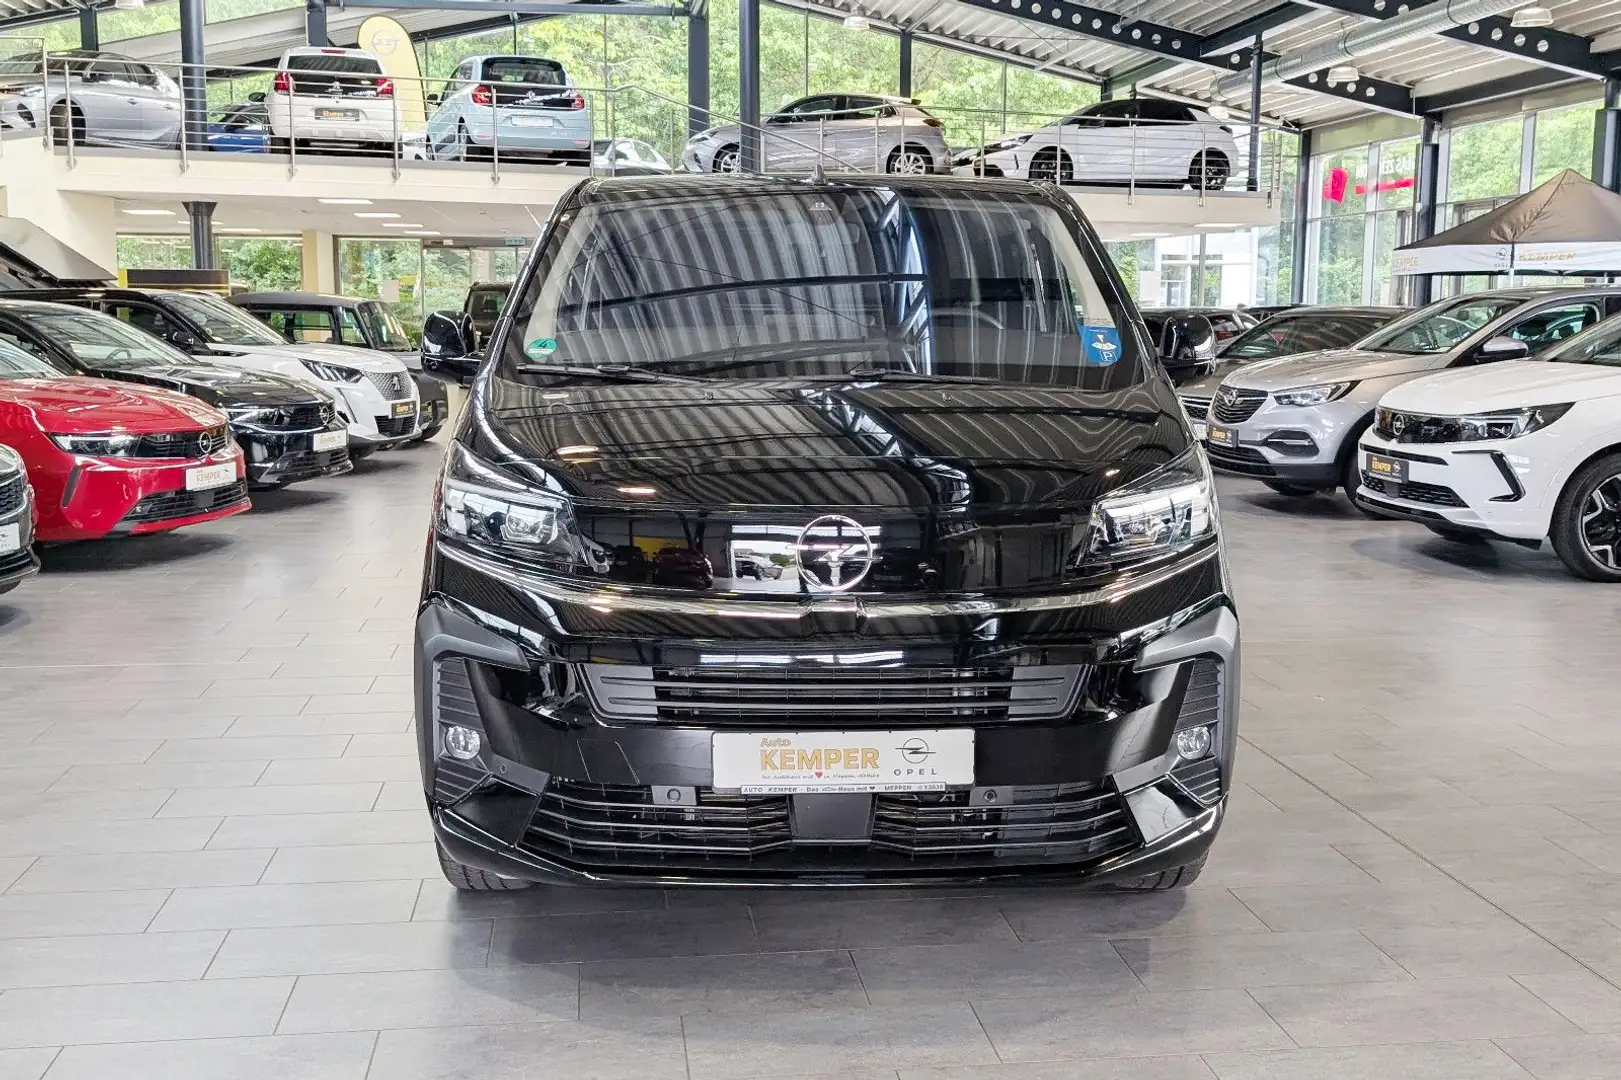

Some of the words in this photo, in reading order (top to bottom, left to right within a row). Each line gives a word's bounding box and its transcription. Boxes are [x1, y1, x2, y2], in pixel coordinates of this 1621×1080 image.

[760, 737, 791, 747] Auto
[760, 747, 880, 770] KEMPER
[893, 768, 937, 776] OPEL
